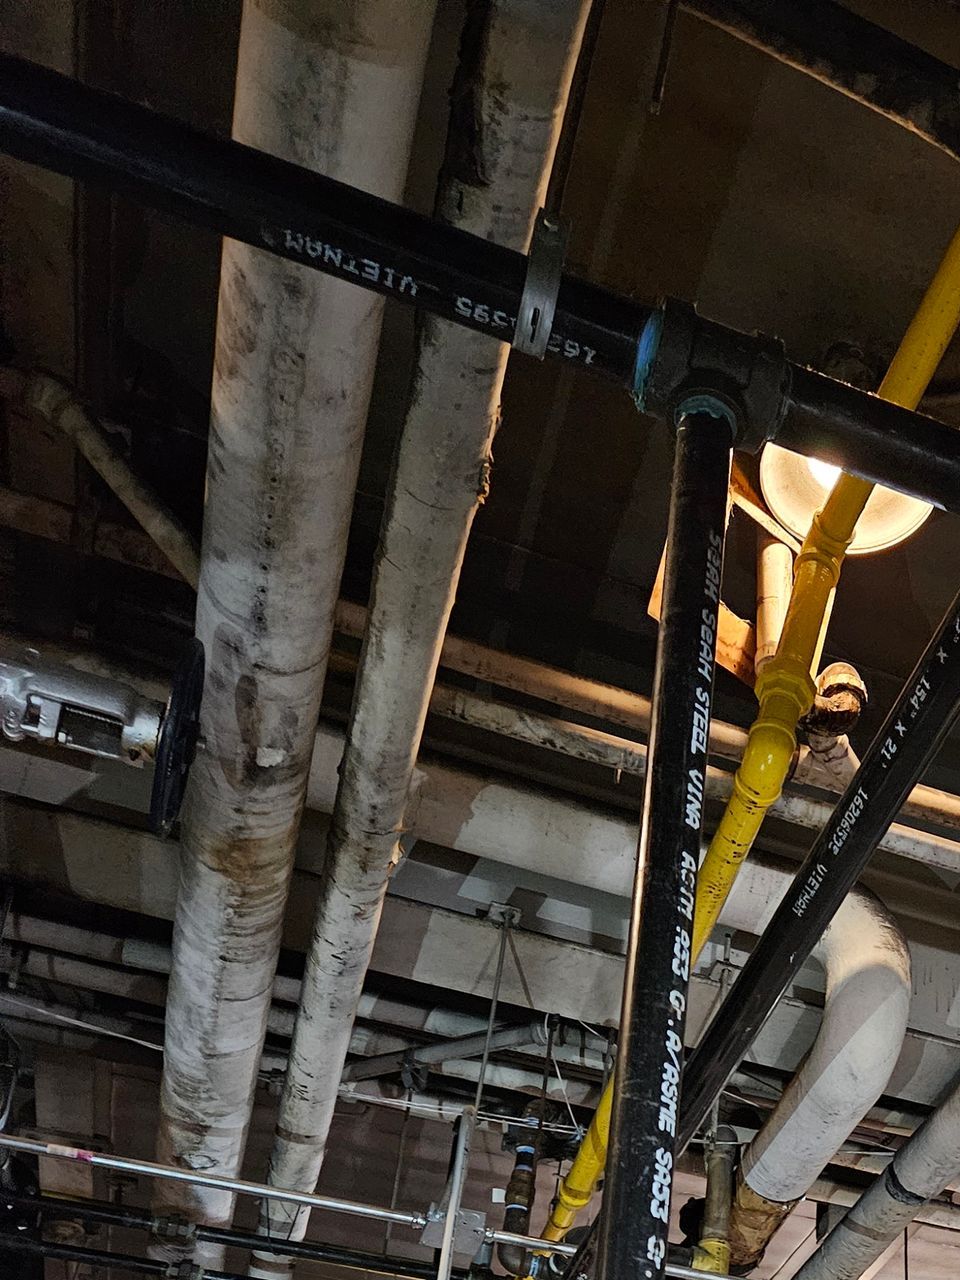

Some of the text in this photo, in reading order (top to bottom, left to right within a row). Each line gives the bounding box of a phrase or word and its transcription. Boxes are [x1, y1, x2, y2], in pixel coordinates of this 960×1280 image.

[283, 229, 419, 297] VIETNAM
[690, 686, 711, 754] STEEL
[894, 719, 908, 737] X
[685, 768, 704, 831] VINA
[650, 1146, 674, 1224] SA53
